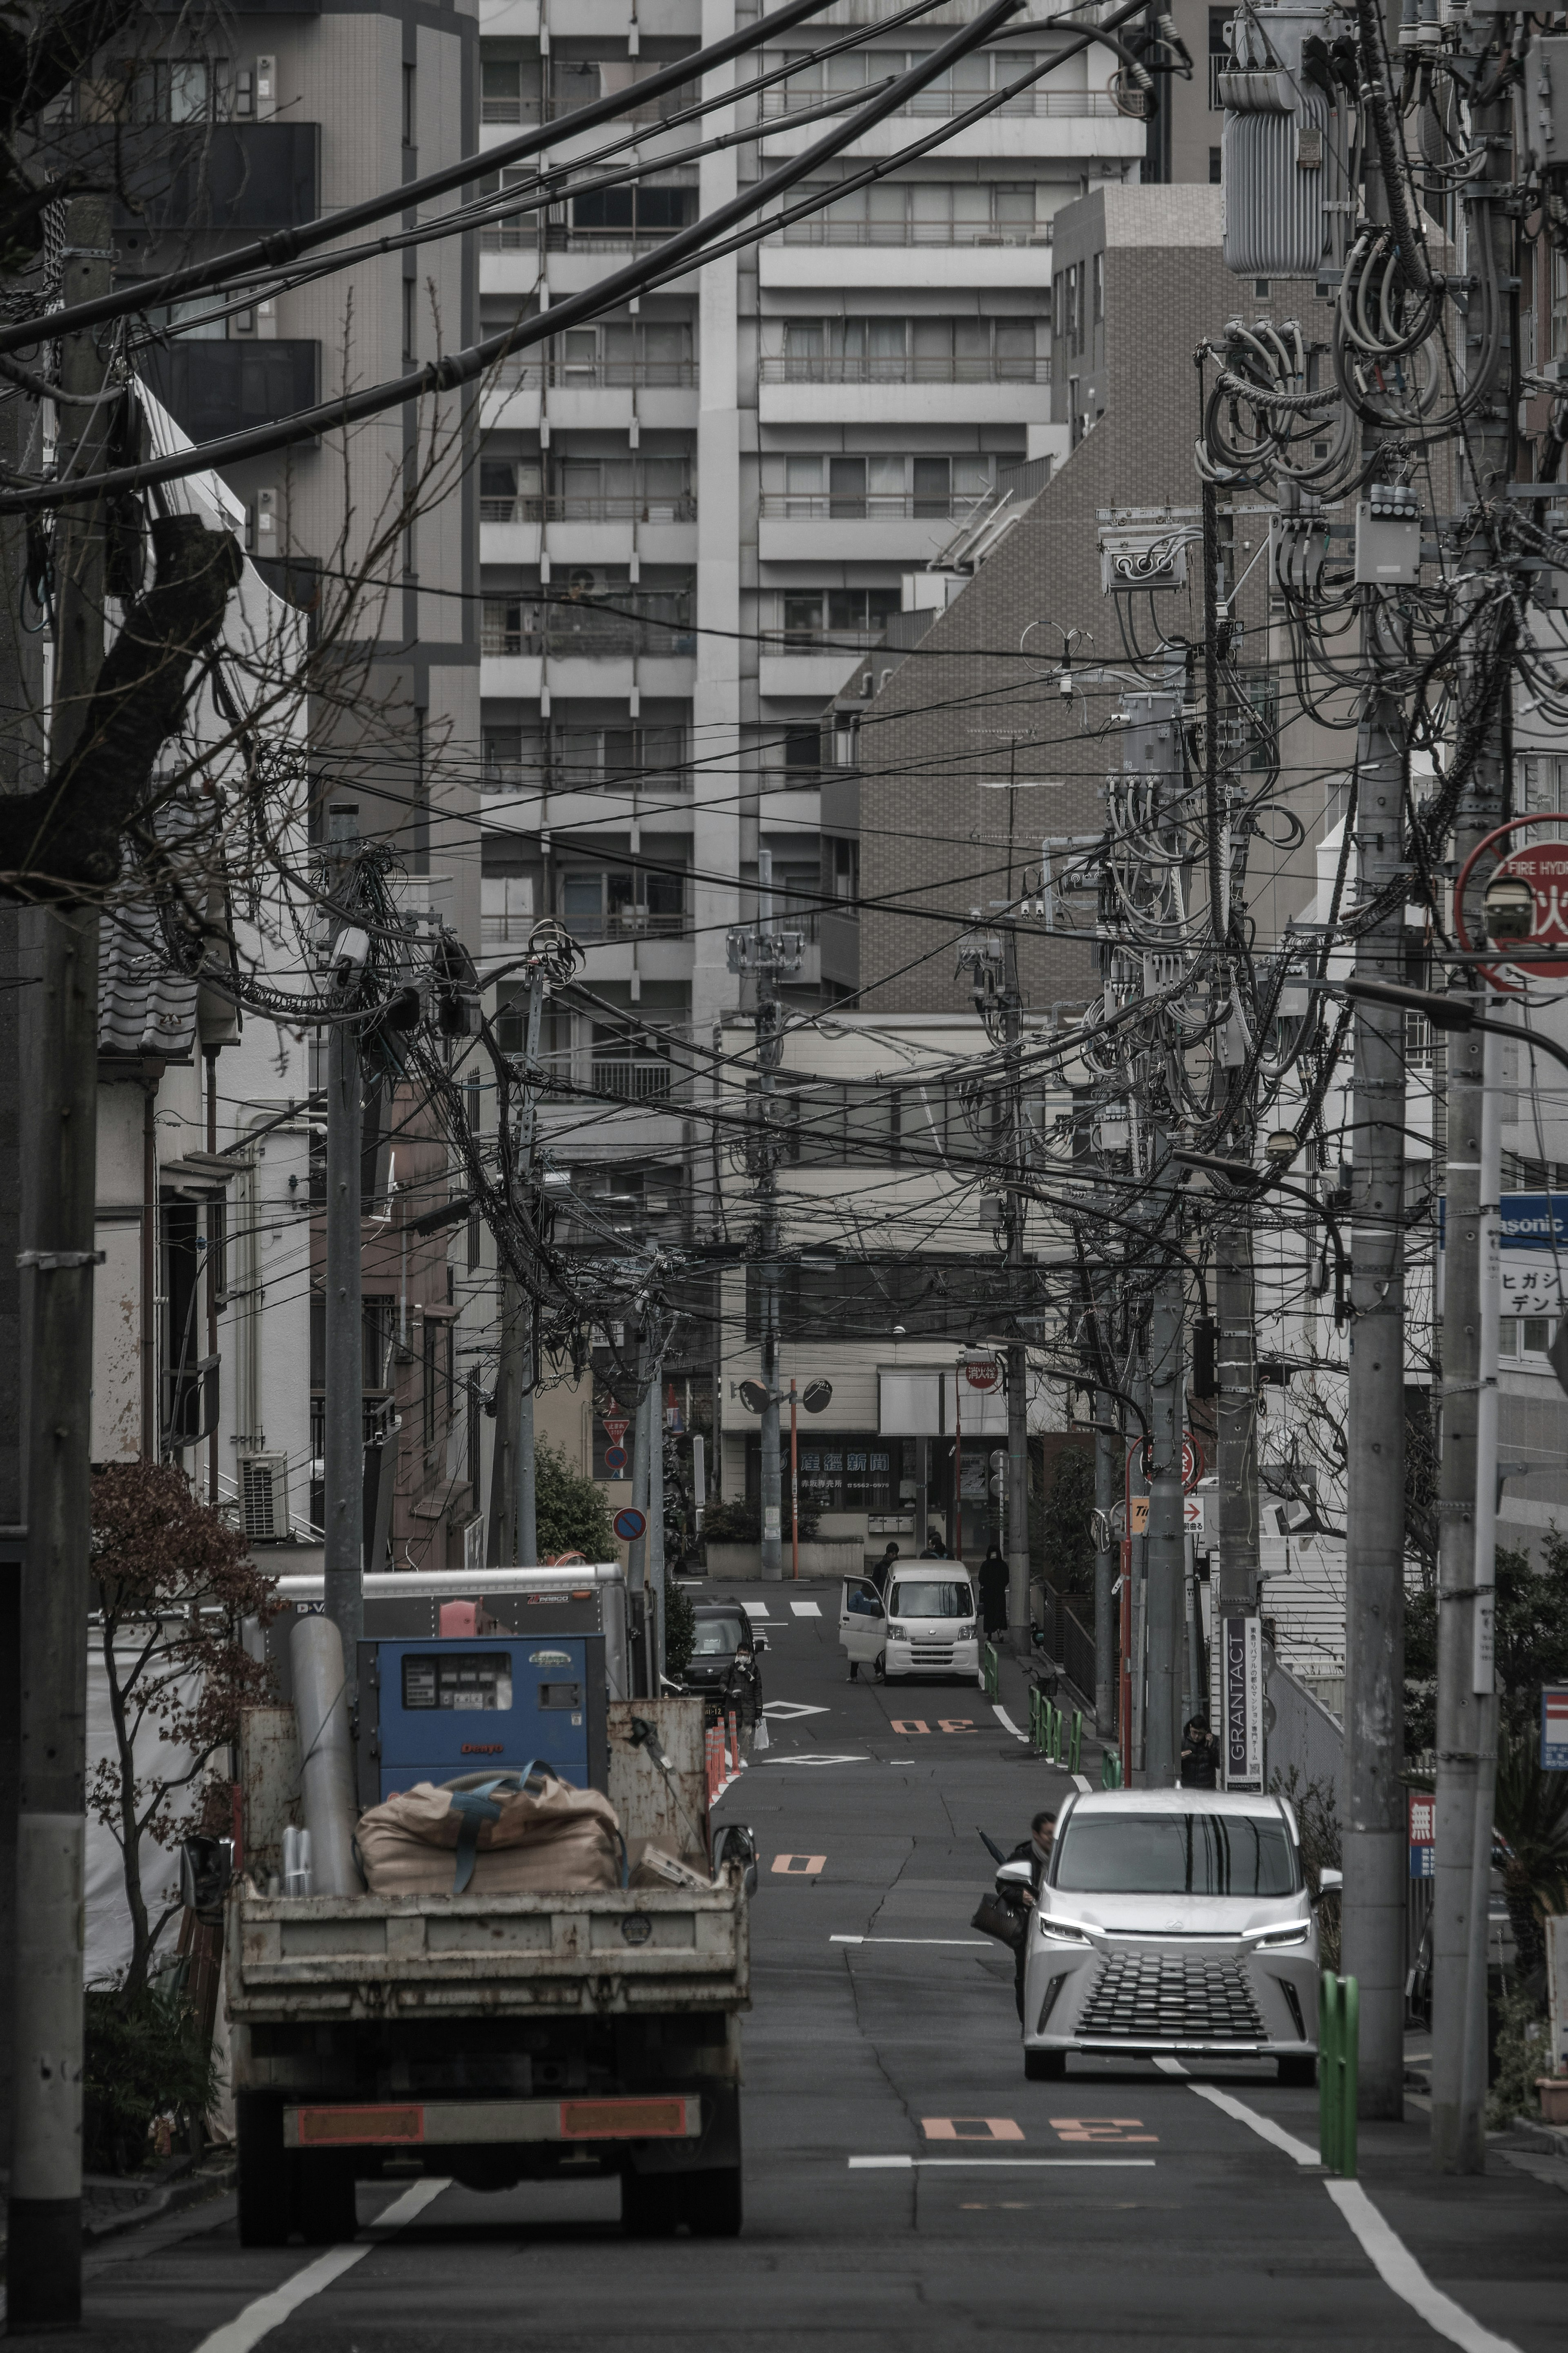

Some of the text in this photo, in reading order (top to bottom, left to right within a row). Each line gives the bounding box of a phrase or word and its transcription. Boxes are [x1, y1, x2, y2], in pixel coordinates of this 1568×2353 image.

[1508, 862, 1537, 875] FIRE
[1503, 1273, 1559, 1289] ヒガシ
[968, 1367, 996, 1379] 消火栓
[801, 1454, 889, 1471] 産經新聞
[801, 1480, 842, 1488] 赤坂専売所
[1136, 1506, 1149, 1516] Ti
[1229, 1634, 1245, 1760] GRANTACT
[461, 1743, 503, 1755] Denyo
